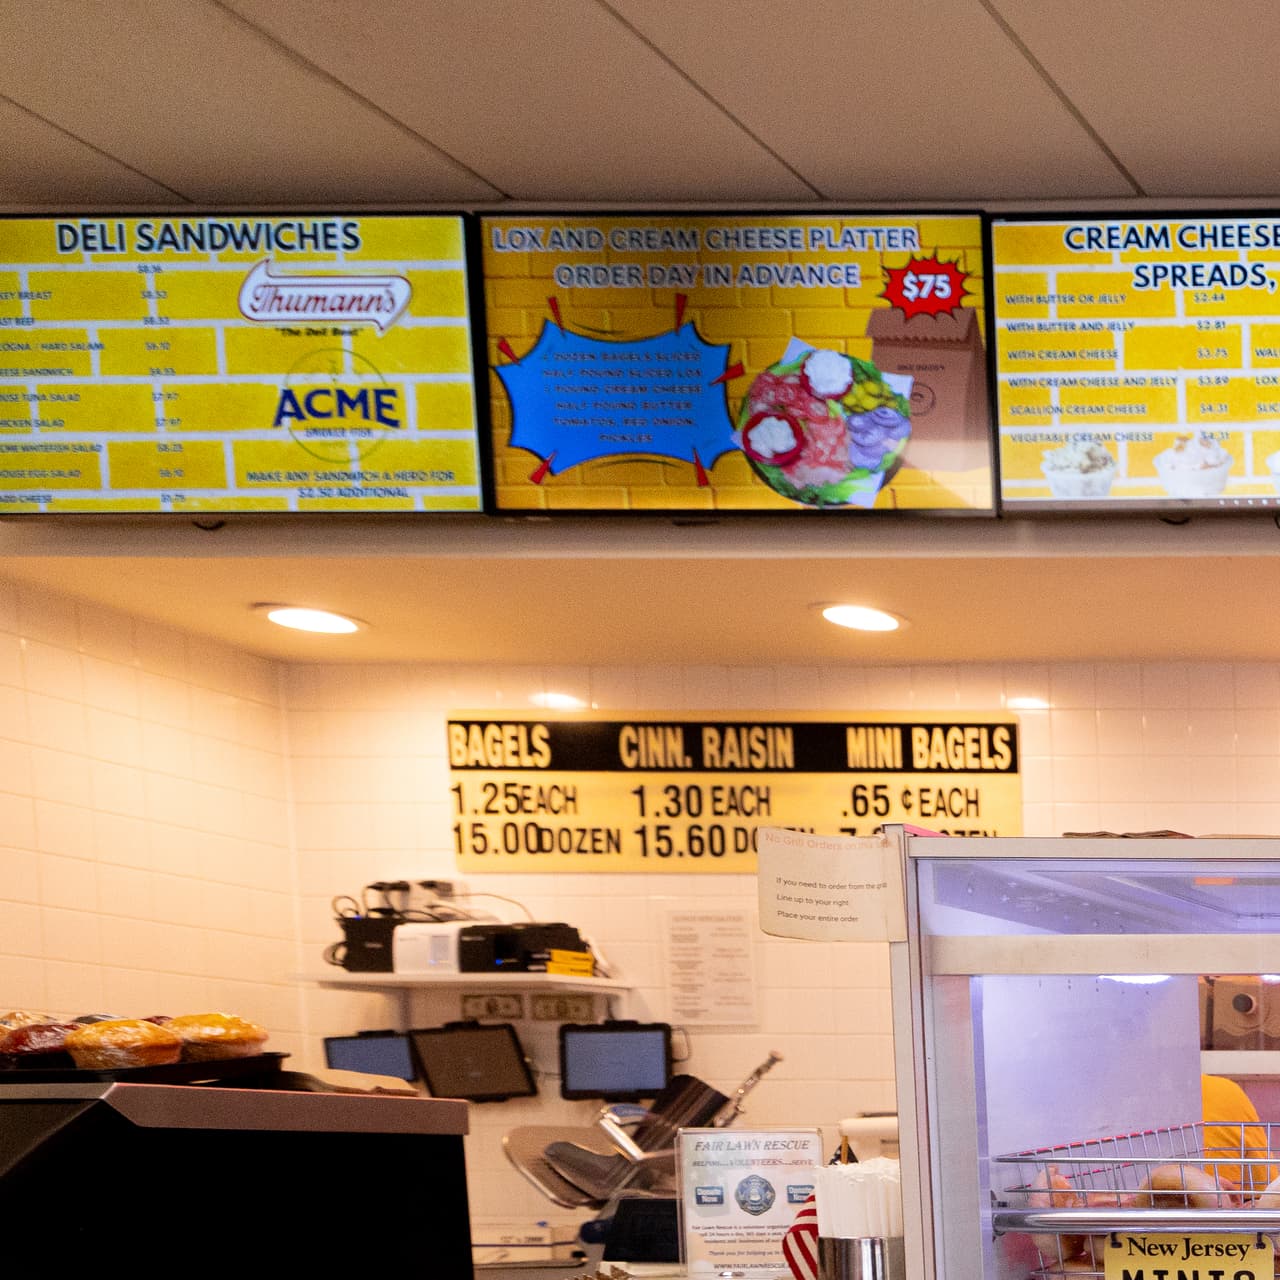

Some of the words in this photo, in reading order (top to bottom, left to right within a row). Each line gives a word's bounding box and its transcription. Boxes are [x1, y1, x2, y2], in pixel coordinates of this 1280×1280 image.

[56, 222, 126, 252] DELI
[136, 222, 361, 252] SANDWICHES
[493, 229, 546, 251] LOX
[549, 229, 604, 251] AND
[611, 228, 699, 251] CREAM
[706, 228, 806, 250] CHEESE
[809, 227, 919, 251] PLATTER
[1065, 225, 1171, 250] CREAM
[555, 265, 642, 289] ORDER
[646, 264, 701, 288] DAY
[703, 264, 733, 288] IN
[736, 264, 860, 288] ADVANCE
[902, 273, 952, 302] $75
[1132, 263, 1277, 291] SPREADS,
[1256, 375, 1278, 385] LOX
[273, 388, 400, 428] ACME
[450, 722, 551, 768] BAGELS
[619, 725, 693, 768] CINN.
[701, 726, 794, 769] RAISIN
[846, 726, 902, 769] MINI
[911, 726, 1012, 769] BAGELS
[451, 783, 520, 815] 1.25
[519, 786, 578, 815] EACH
[632, 784, 704, 817] 1.30
[711, 785, 772, 817] EACH
[920, 788, 980, 818] EACH
[452, 822, 541, 854] 15.00
[538, 827, 621, 854] DOZEN
[634, 825, 726, 858] 15.60
[776, 893, 793, 902] Line
[815, 899, 832, 907] your
[833, 899, 849, 907] right
[777, 909, 799, 920] Place
[800, 914, 816, 922] your
[818, 914, 838, 922] entire
[840, 915, 859, 923] order
[764, 1139, 810, 1151] RESCUE
[1127, 1236, 1177, 1258] New
[1181, 1237, 1251, 1263] Jersey
